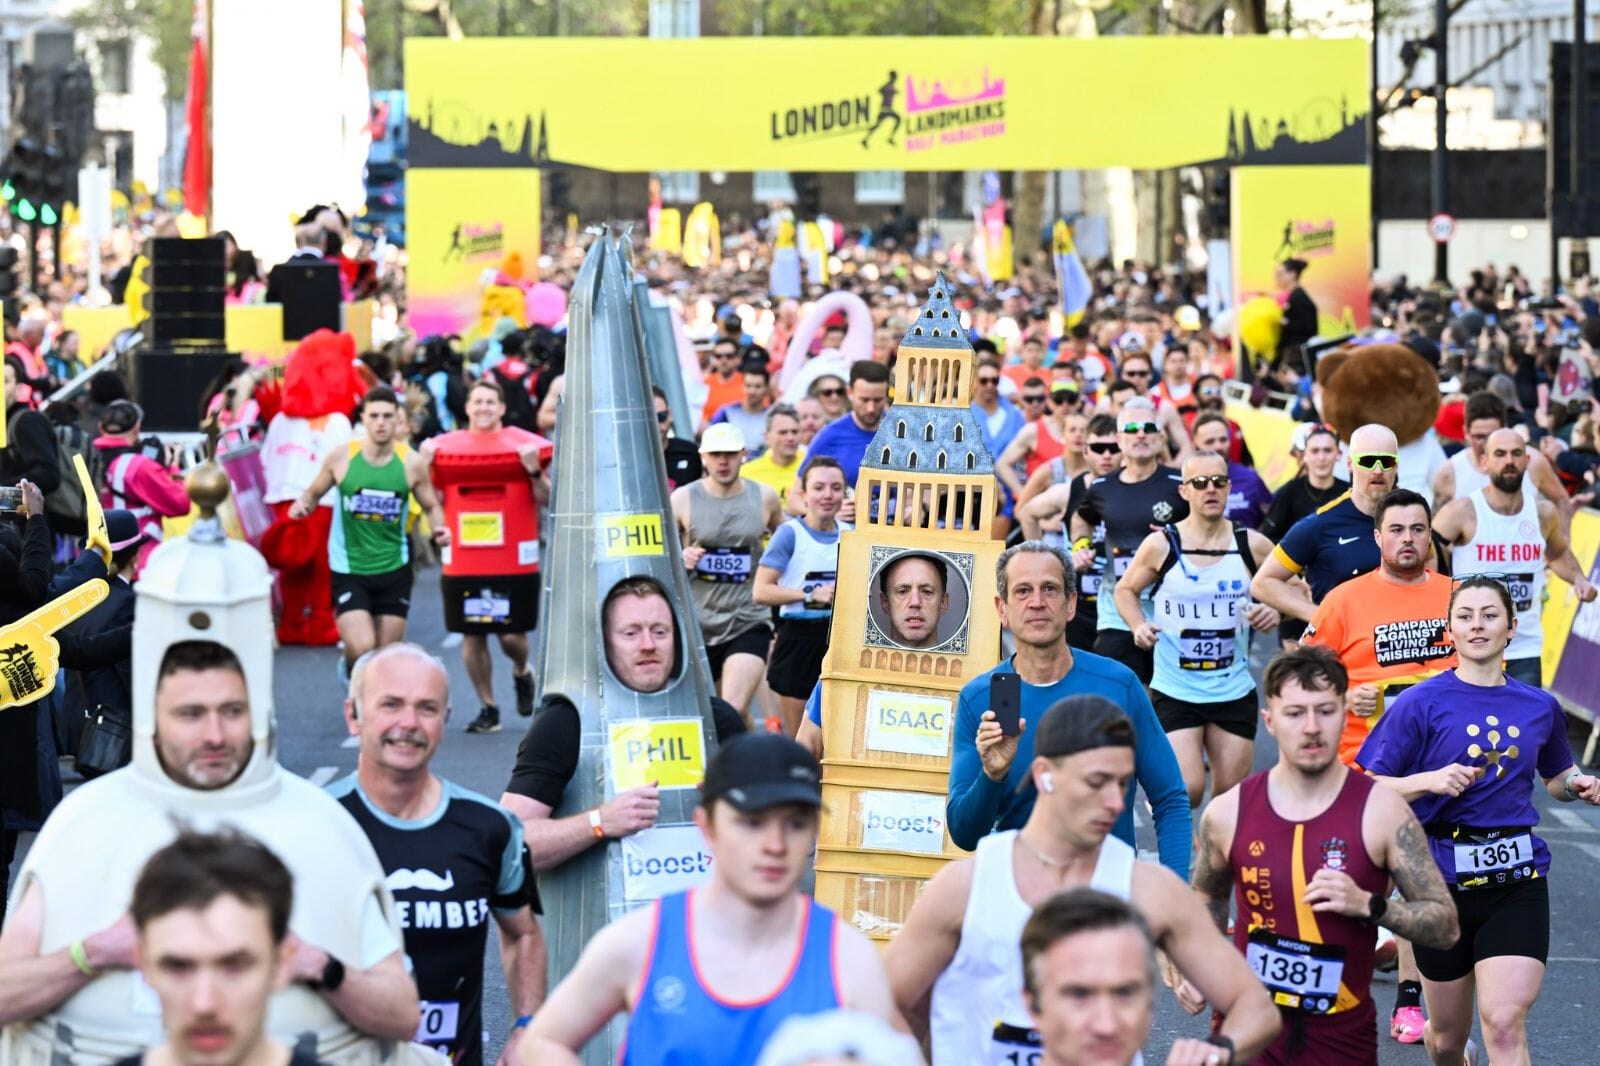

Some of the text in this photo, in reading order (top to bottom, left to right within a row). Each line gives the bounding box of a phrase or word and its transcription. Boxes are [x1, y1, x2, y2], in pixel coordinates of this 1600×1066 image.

[771, 96, 871, 140] LONDON
[606, 524, 664, 548] PHIL
[706, 557, 743, 571] 1852
[1476, 543, 1506, 562] THE
[1374, 618, 1448, 635] CAMPAIGN
[1376, 628, 1438, 643] AGAINST
[1192, 641, 1223, 656] 421
[1375, 637, 1428, 654] LIVING
[1377, 644, 1454, 663] MISERABLY
[12, 657, 37, 695] LONDON
[880, 707, 945, 731] ISAAC
[626, 737, 692, 764] PHIL
[627, 851, 706, 876] boost
[1469, 840, 1520, 868] 1361
[1259, 867, 1274, 910] CLUB
[1277, 938, 1311, 953] HAYDEN
[1259, 953, 1323, 989] 1381
